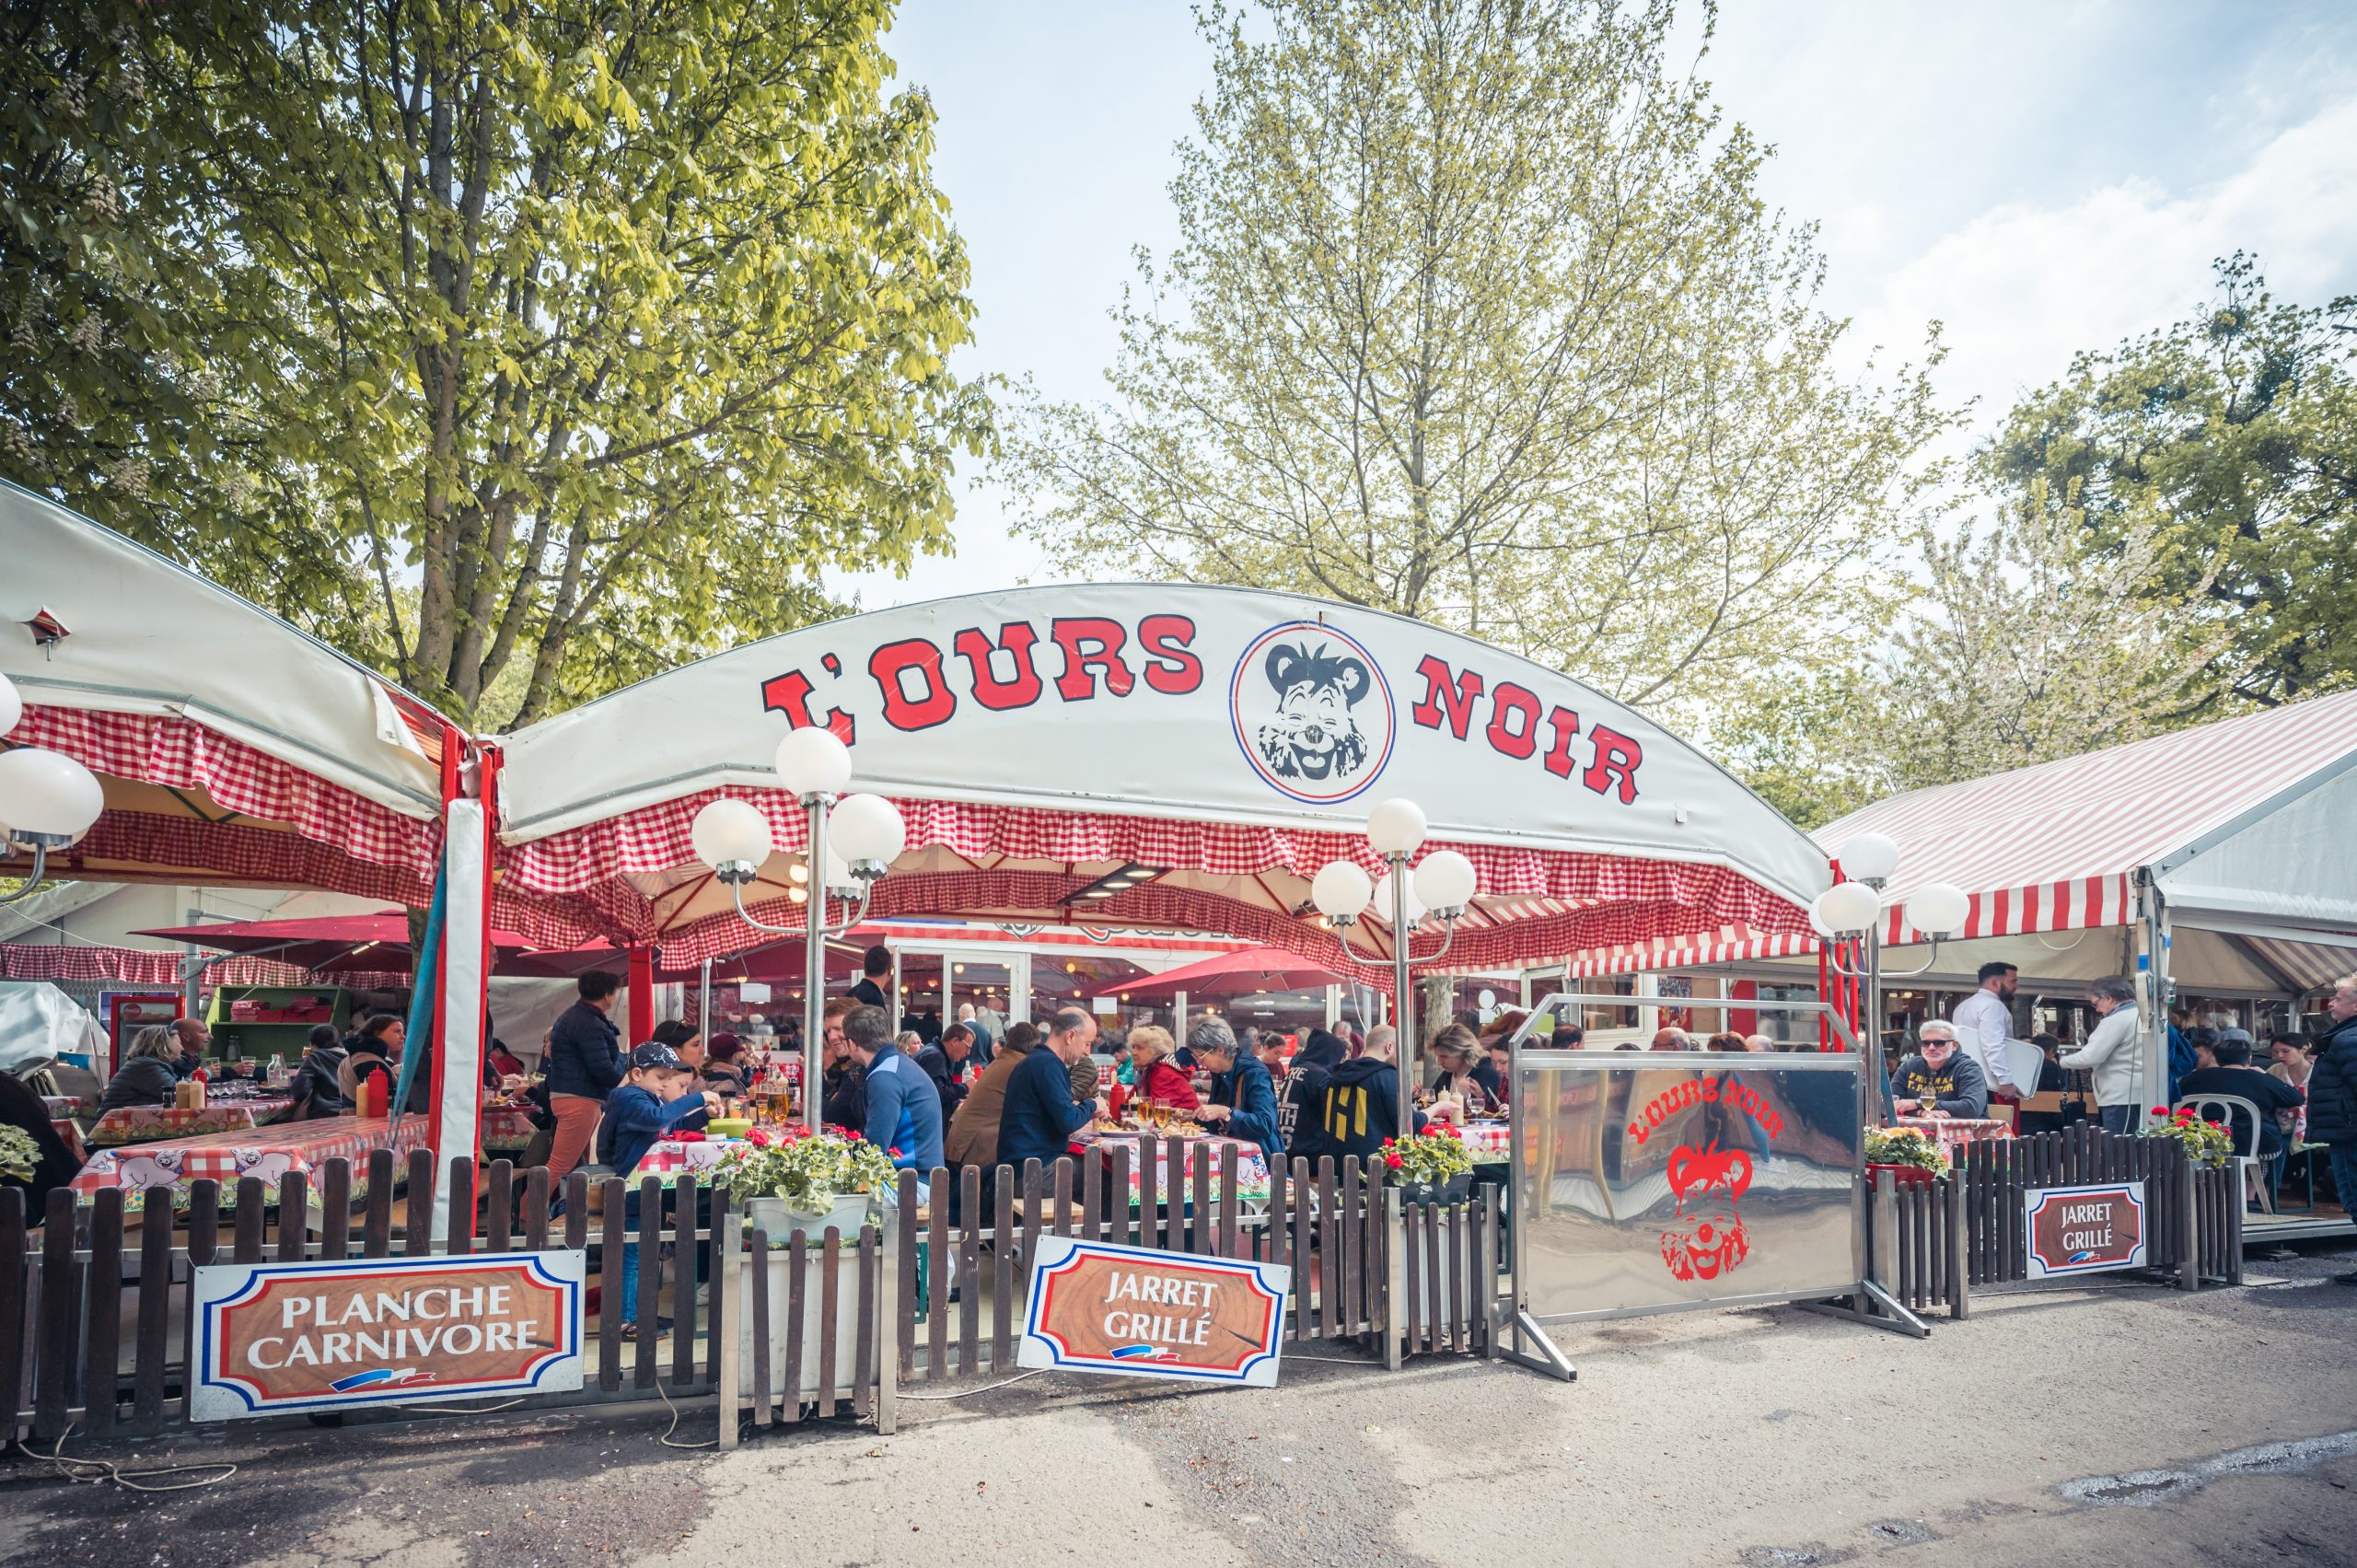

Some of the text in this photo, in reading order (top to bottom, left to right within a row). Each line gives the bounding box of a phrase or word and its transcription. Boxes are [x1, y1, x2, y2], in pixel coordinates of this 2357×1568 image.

[761, 613, 1643, 806] L'OURS NOIR
[1628, 1077, 1783, 1144] L'OURS NOIR
[2061, 1202, 2113, 1229] JARRET
[2062, 1223, 2113, 1251] GRILLÉ
[282, 1284, 511, 1329] PLANCHE
[1104, 1272, 1219, 1308] JARRET
[247, 1319, 539, 1370] CARNIVORE
[1104, 1311, 1212, 1346] GRILLÉ
